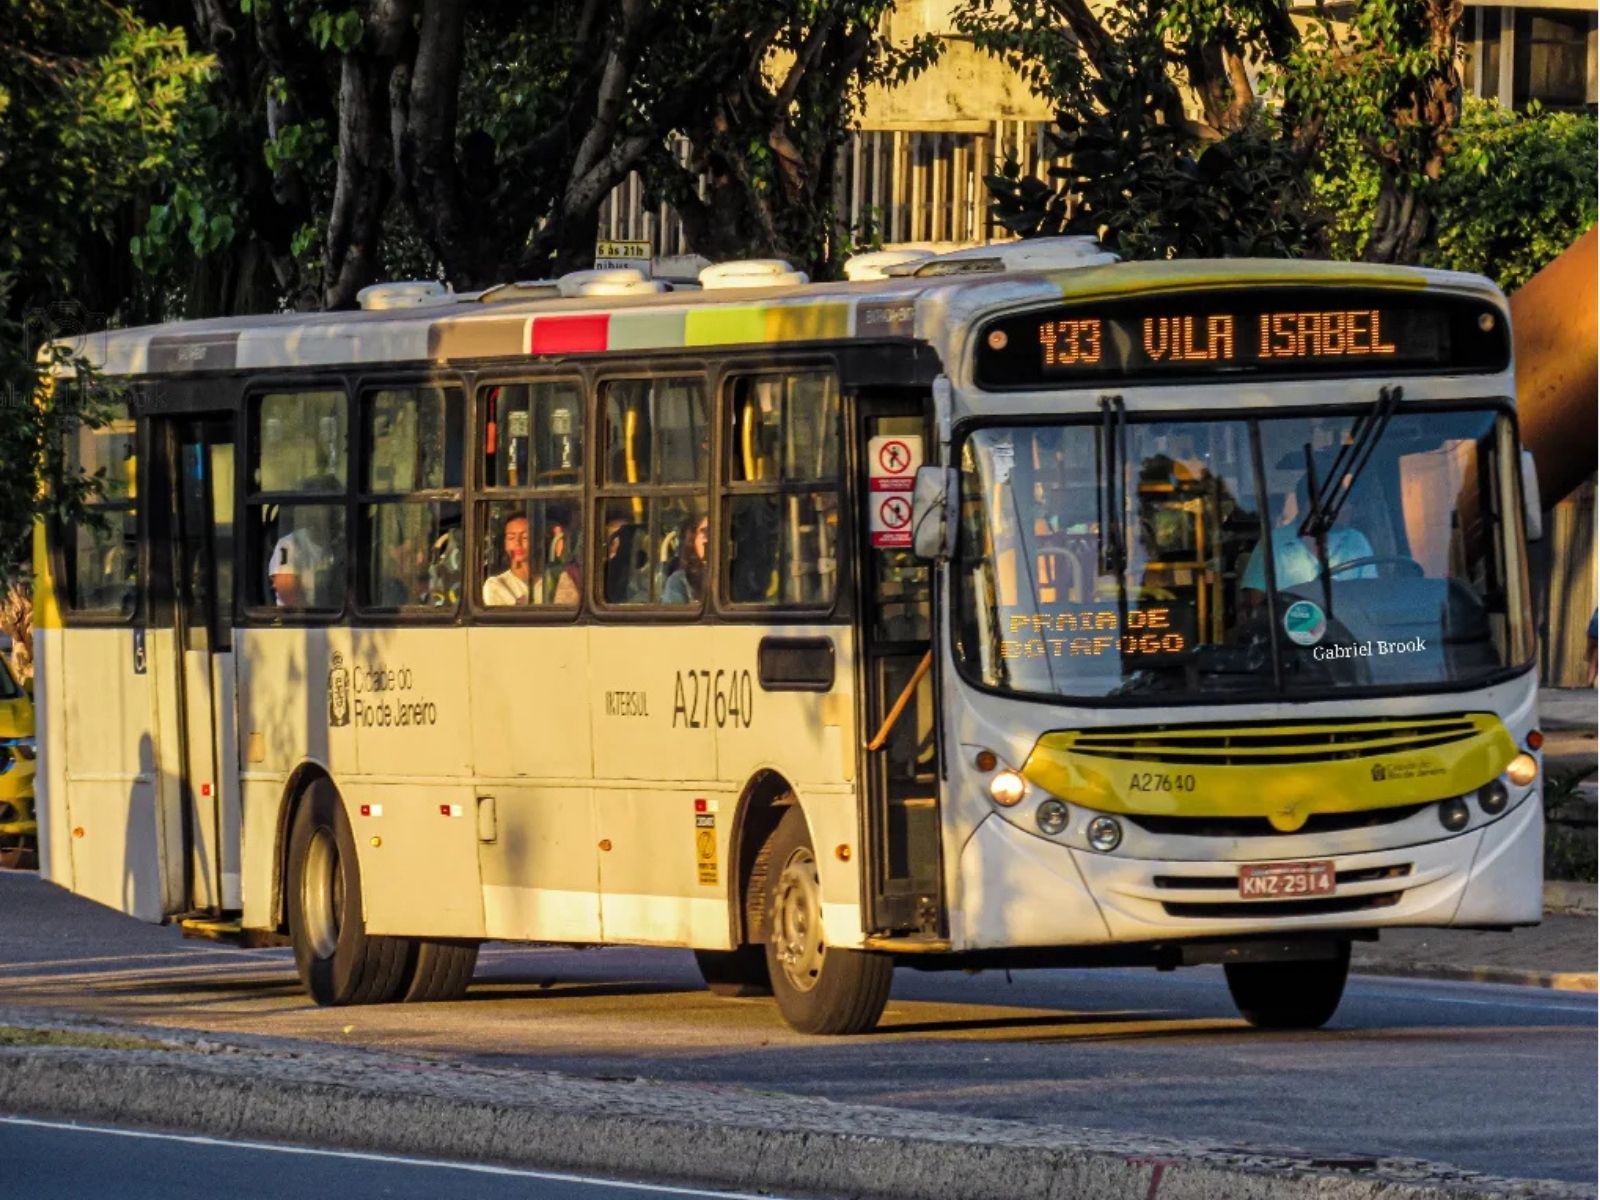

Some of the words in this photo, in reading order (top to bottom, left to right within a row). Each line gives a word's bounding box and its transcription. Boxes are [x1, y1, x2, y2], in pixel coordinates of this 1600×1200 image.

[623, 245, 644, 256] 21h
[597, 260, 629, 269] nibus
[1040, 319, 1101, 364] 433
[1143, 314, 1233, 360] VILA
[1258, 310, 1395, 358] ISABEL
[1009, 611, 1118, 633] PRAIA
[1127, 608, 1170, 629] DE
[1001, 633, 1184, 658] BOTAFOGO
[605, 690, 649, 717] INTERSUL
[672, 668, 753, 729] A27640
[354, 698, 374, 727] Rio
[376, 698, 391, 727] de
[394, 697, 437, 727] Janeiro
[1129, 772, 1195, 792] A27640
